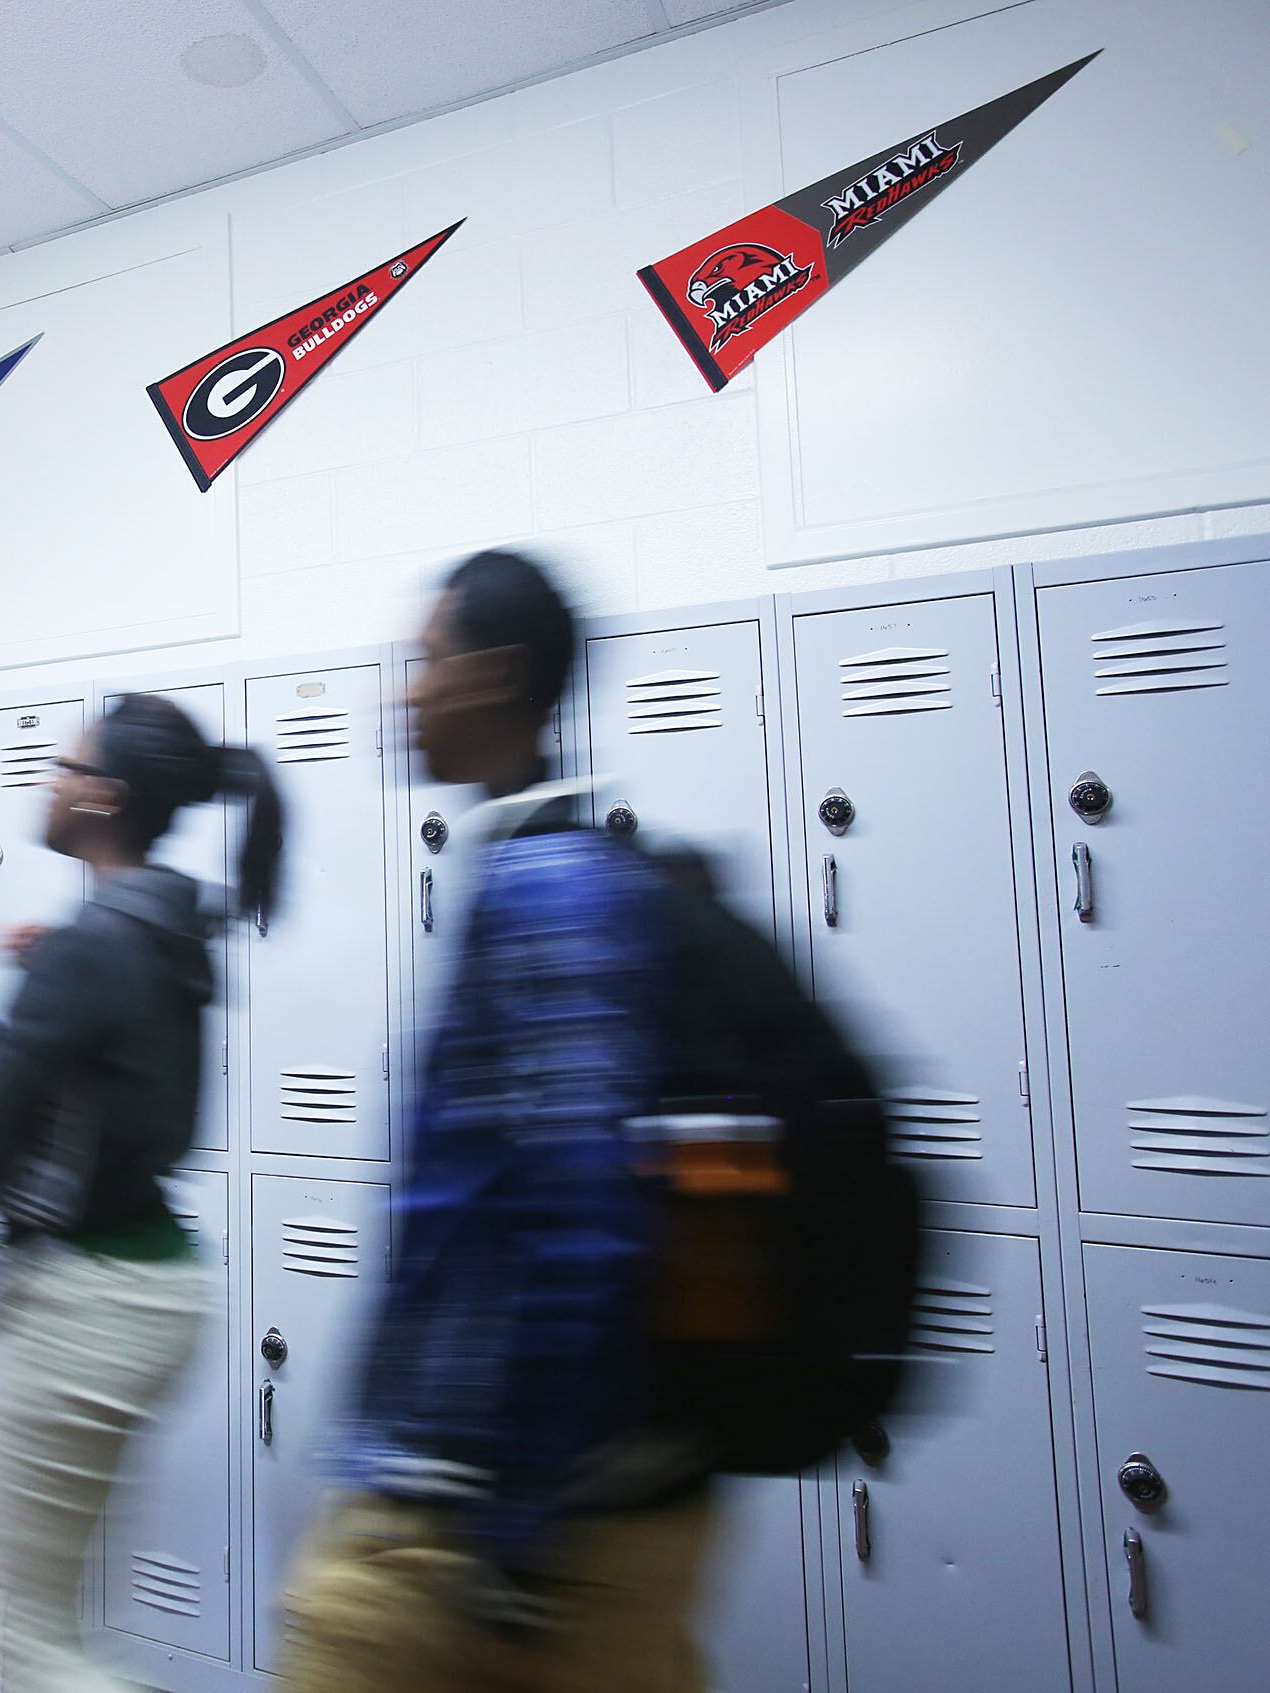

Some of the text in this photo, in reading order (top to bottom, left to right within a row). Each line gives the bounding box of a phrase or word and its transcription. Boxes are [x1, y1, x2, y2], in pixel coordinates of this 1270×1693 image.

[828, 136, 943, 218] MIAMI
[286, 283, 372, 348] GEORGIA
[292, 291, 379, 361] BULLDOGS
[712, 258, 801, 328] MIAMI
[182, 347, 286, 441] G
